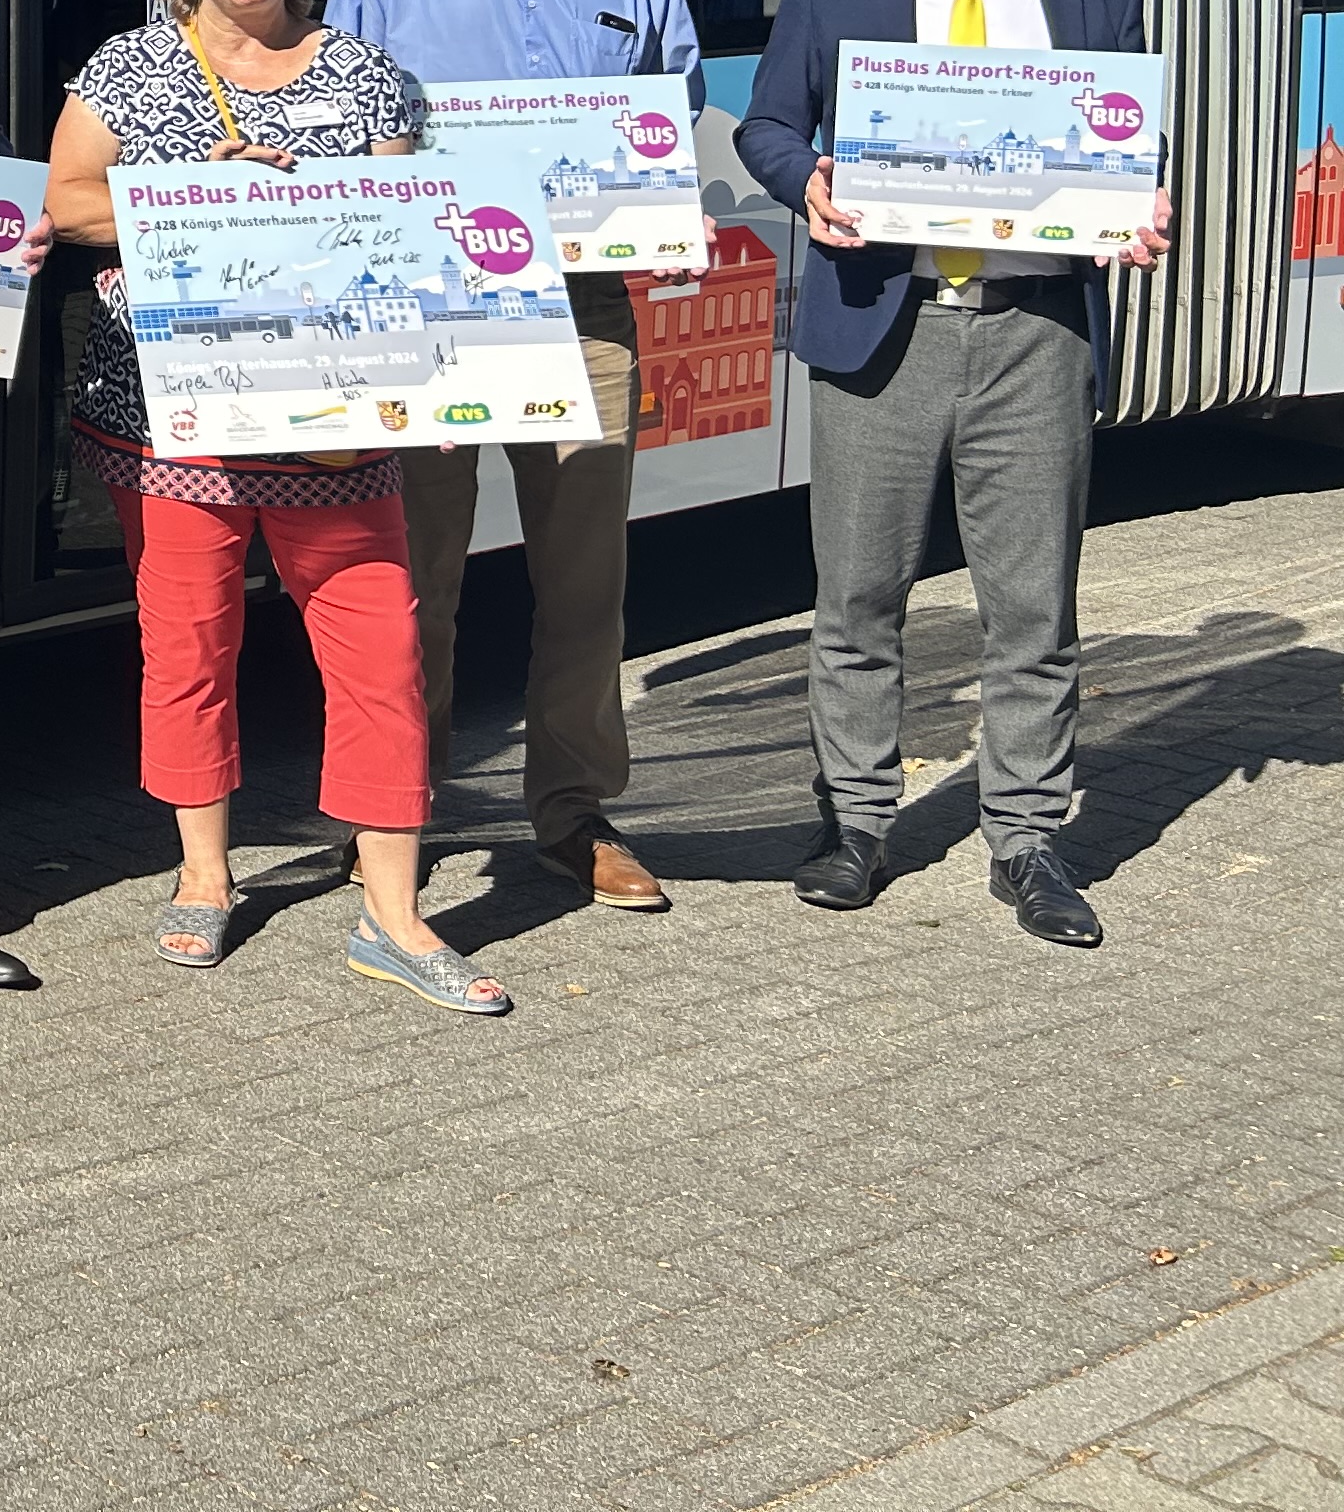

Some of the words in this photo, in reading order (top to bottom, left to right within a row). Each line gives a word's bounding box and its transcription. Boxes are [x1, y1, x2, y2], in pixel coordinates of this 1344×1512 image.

[851, 56, 929, 75] PlusBus
[935, 61, 1095, 85] Airport-Region
[412, 97, 482, 113] PlusBus
[489, 91, 629, 113] Airport-Region
[129, 184, 237, 208] PlusBus
[246, 176, 457, 207] Airport-Region
[154, 220, 177, 231] 428
[181, 218, 223, 231] Königs
[226, 215, 318, 229] Wusterhausen
[341, 212, 382, 223] Erkner
[166, 361, 212, 375] Königs
[338, 353, 383, 369] August
[387, 351, 419, 364] 2024
[452, 408, 485, 420] RVS
[172, 421, 195, 431] VBB
